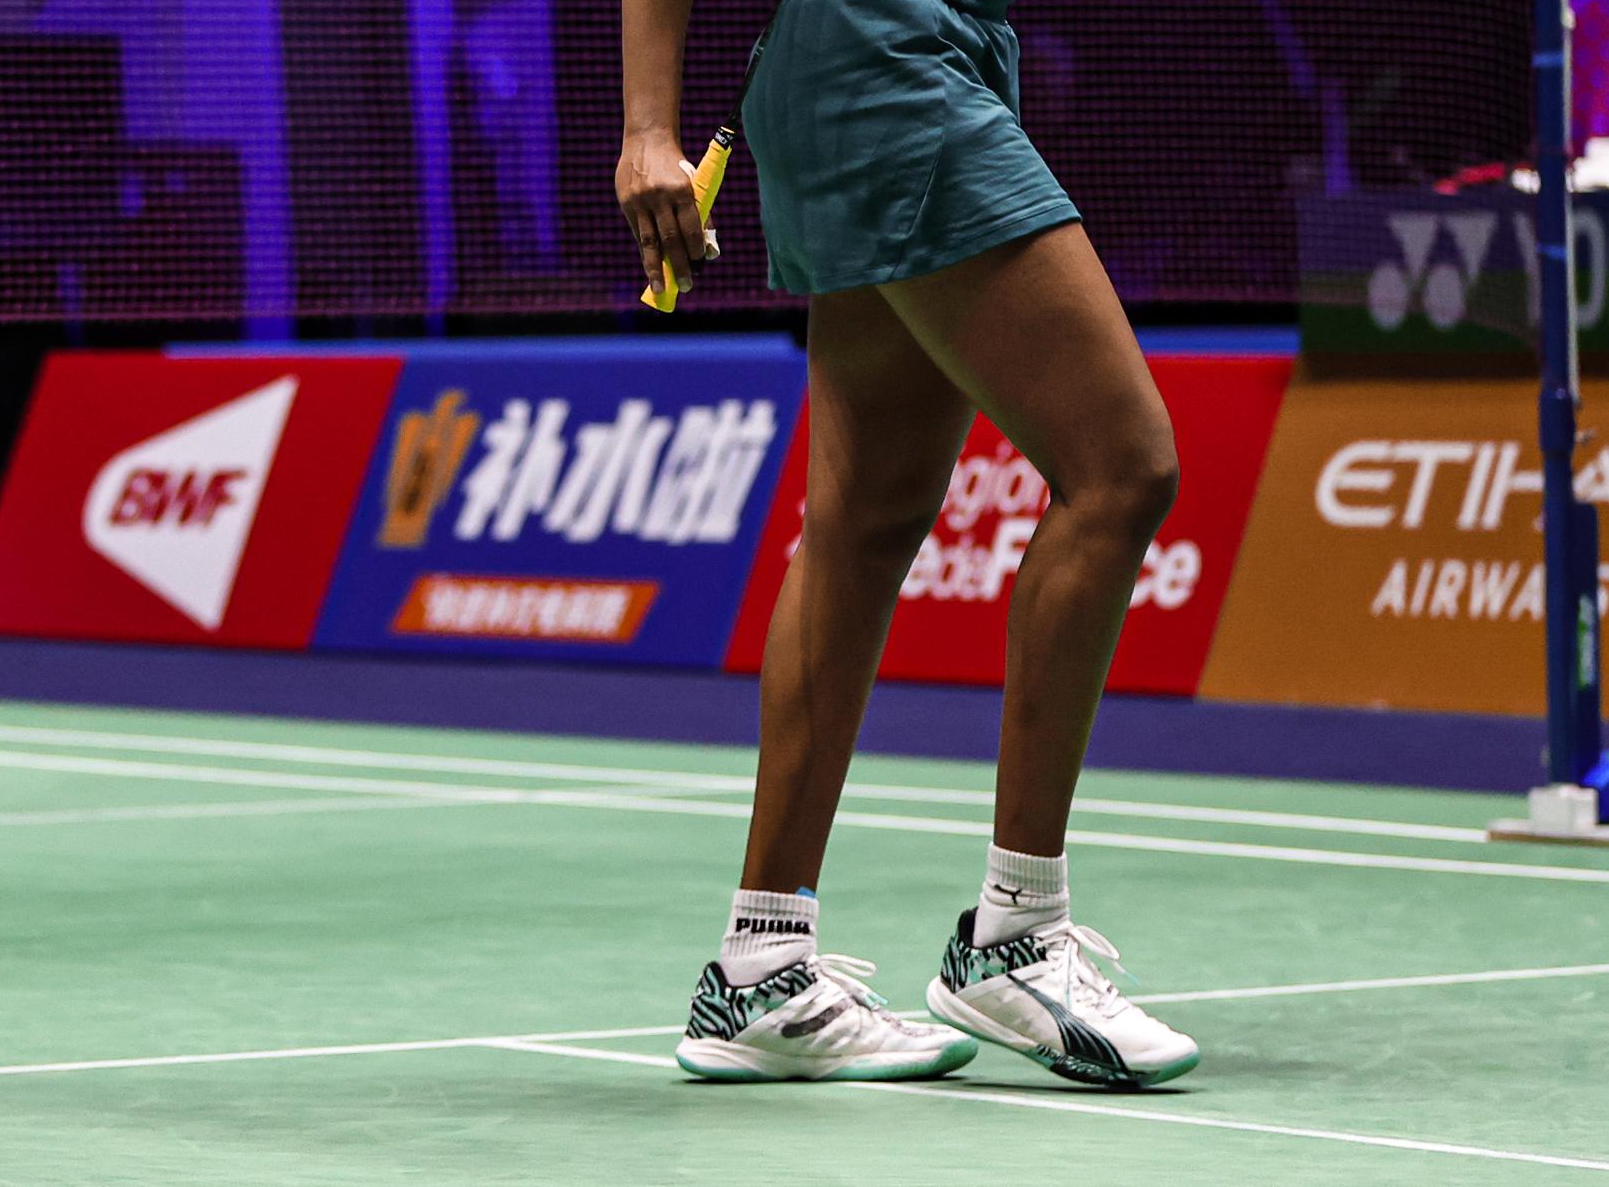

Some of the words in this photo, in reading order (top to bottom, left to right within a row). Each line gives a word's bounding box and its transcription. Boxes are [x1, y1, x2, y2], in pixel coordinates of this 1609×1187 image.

[109, 469, 247, 527] BWF
[452, 397, 780, 544] 补水啦
[735, 918, 810, 934] PUMA
